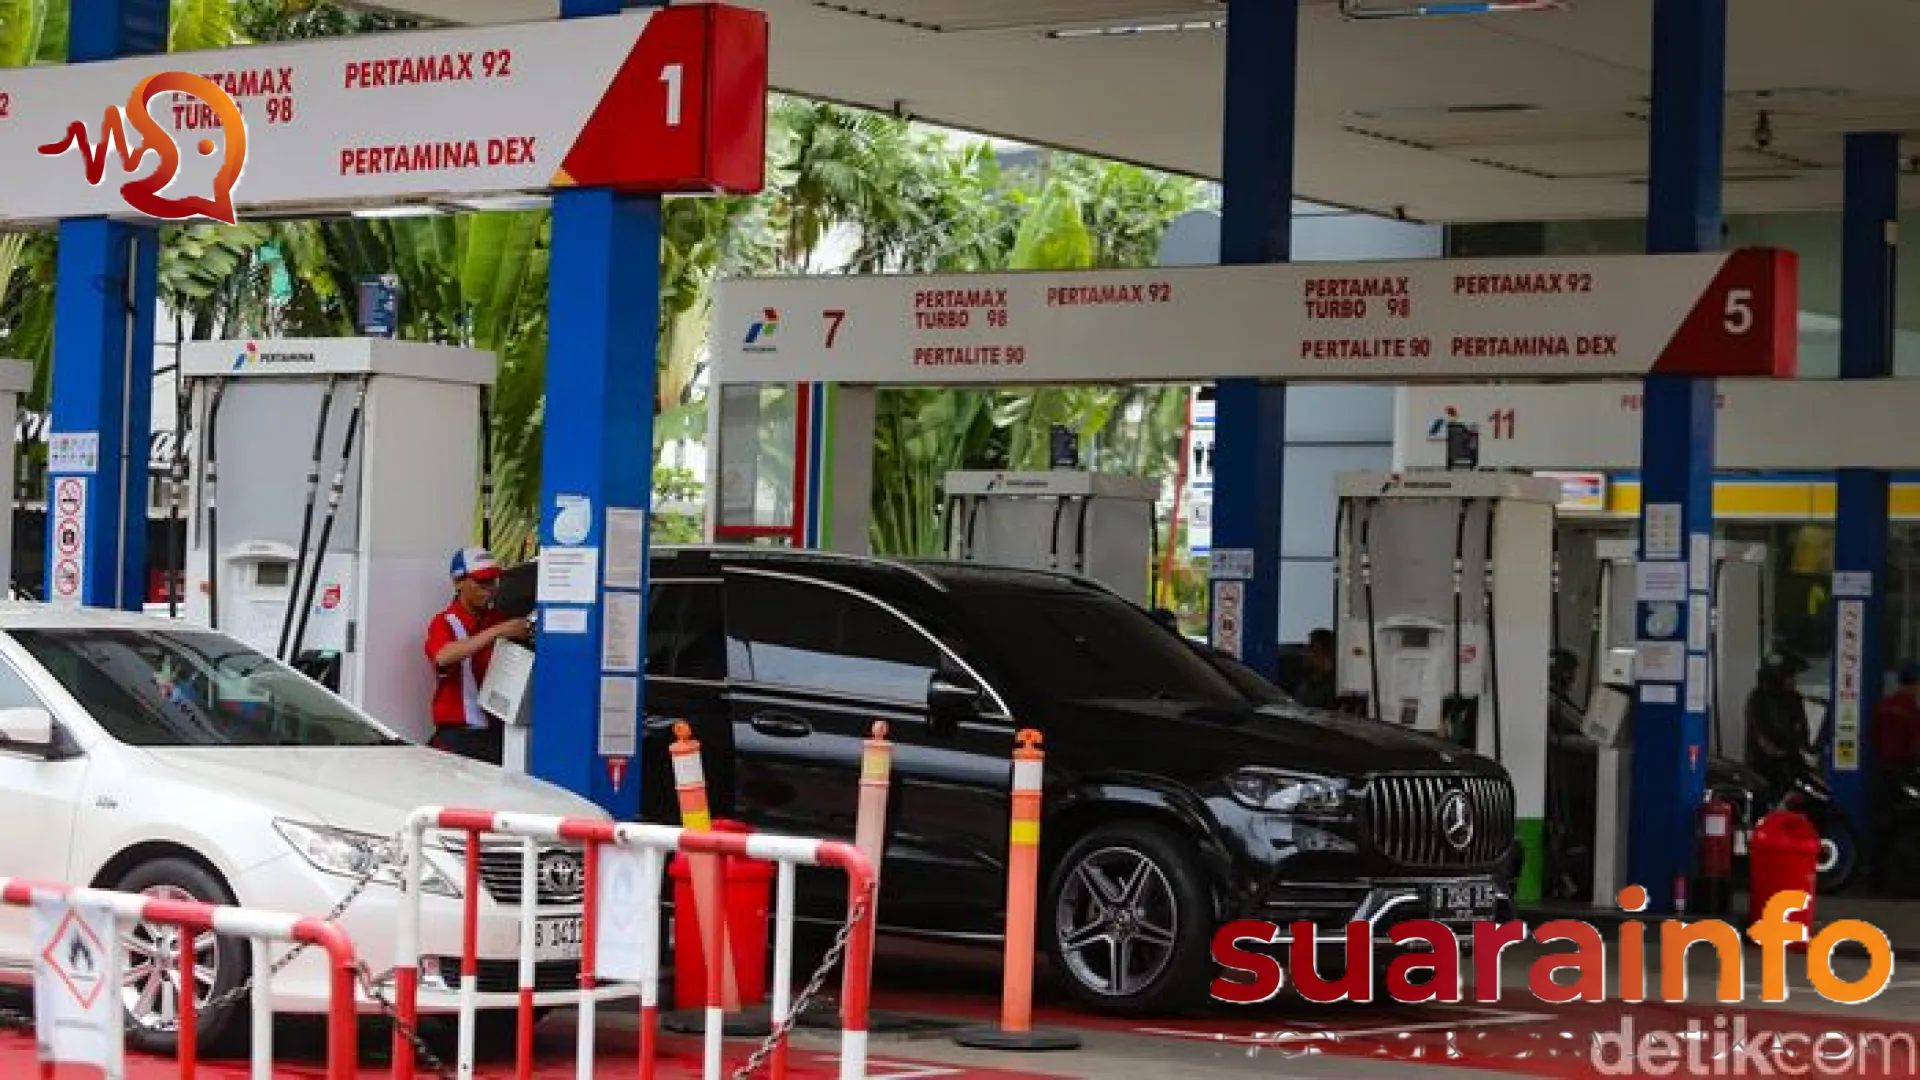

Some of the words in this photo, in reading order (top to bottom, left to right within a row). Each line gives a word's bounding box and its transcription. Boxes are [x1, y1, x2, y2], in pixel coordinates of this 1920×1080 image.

[345, 52, 474, 89] PERTAMAX
[481, 49, 512, 78] 92
[660, 64, 681, 126] 1
[266, 95, 293, 123] 98
[339, 139, 480, 176] PERTAMINA
[486, 137, 537, 167] DEX
[1046, 285, 1143, 306] PERTAMAX
[1148, 282, 1171, 303] 92
[1304, 276, 1409, 298] PERTAMAX
[1453, 273, 1563, 295] PERTAMAX
[1565, 272, 1592, 293] 92
[914, 289, 1007, 308] PERTAMAX
[1305, 299, 1366, 319] TURBO
[1386, 298, 1410, 318] 98
[915, 308, 969, 330] TURBO
[986, 307, 1008, 328] 98
[1722, 289, 1753, 335] 5
[822, 309, 845, 349] 7
[913, 346, 1001, 366] PERTALITE
[1004, 345, 1026, 365] 90
[1301, 338, 1405, 360] PERTALITE
[1408, 337, 1431, 358] 90
[1450, 337, 1569, 358] PERTAMINA
[1575, 336, 1618, 357] DEX
[1489, 410, 1515, 440] 11
